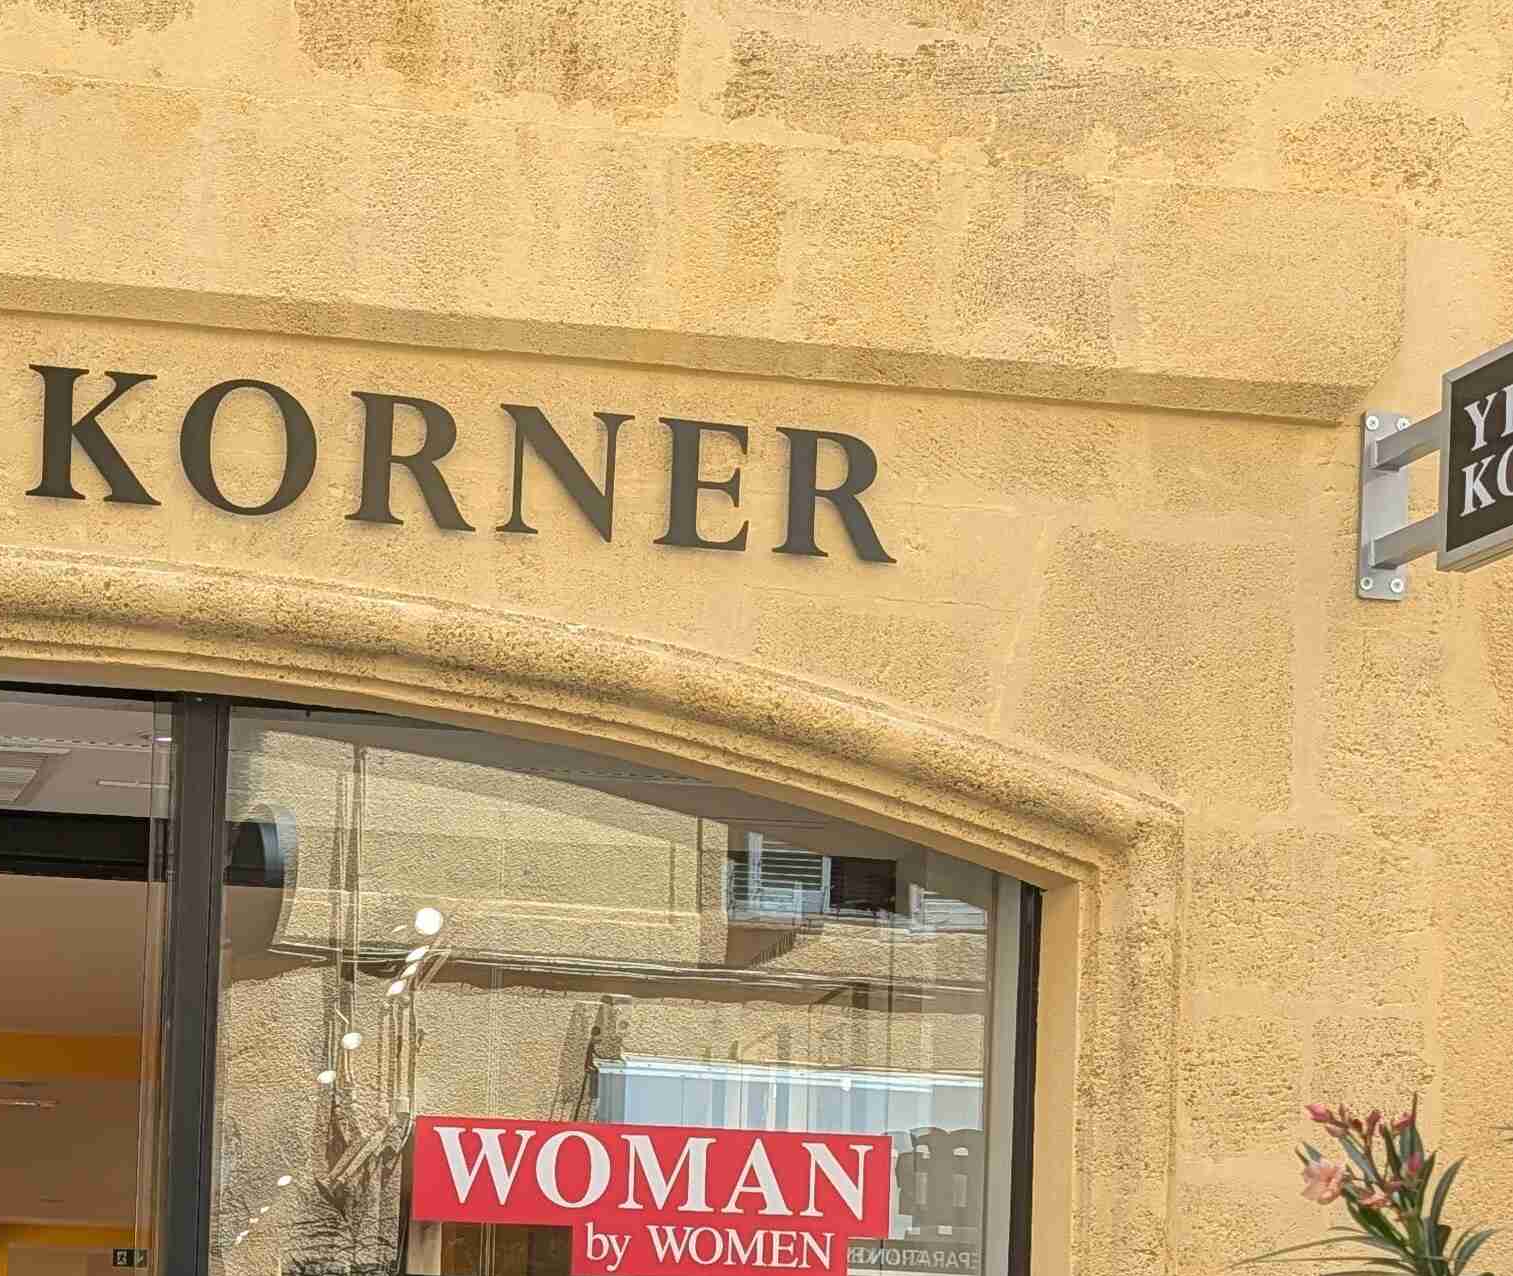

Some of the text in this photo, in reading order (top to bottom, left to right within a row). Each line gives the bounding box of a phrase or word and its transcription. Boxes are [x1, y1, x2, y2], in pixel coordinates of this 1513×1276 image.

[433, 1126, 874, 1221] WOMAN
[585, 1222, 835, 1272] by WOMEN
